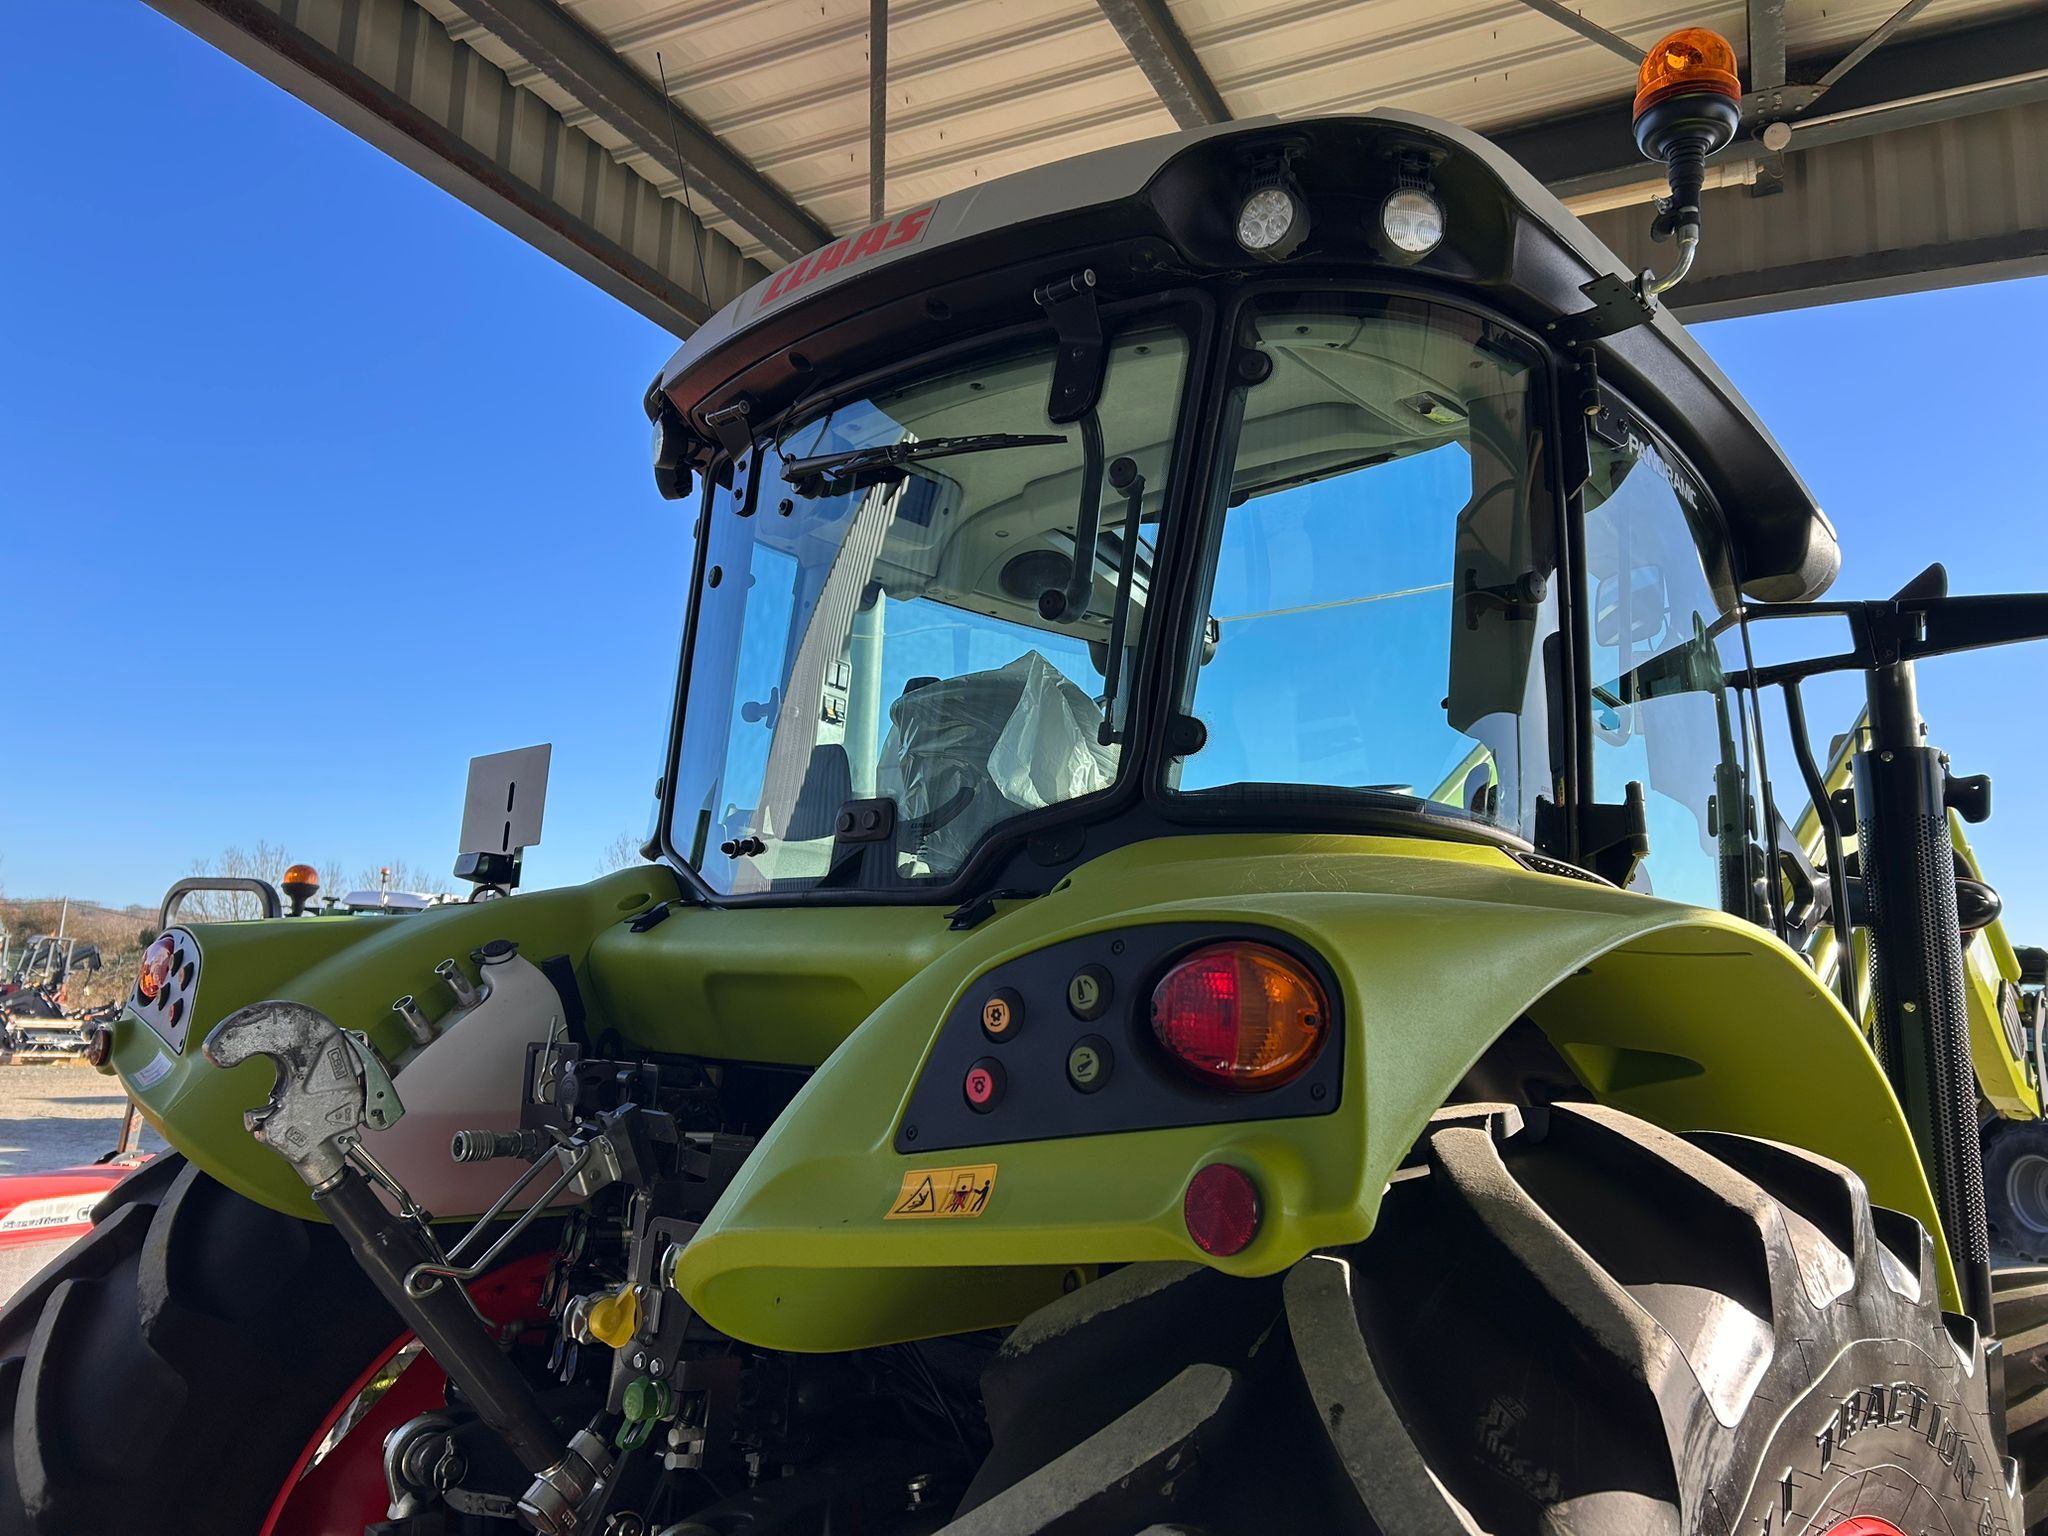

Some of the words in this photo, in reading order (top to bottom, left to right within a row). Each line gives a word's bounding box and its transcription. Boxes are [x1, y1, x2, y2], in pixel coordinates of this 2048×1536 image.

[758, 207, 933, 308] CLAAS
[1627, 432, 1698, 510] PANORAMIC
[1816, 1381, 1976, 1500] TRACTION
